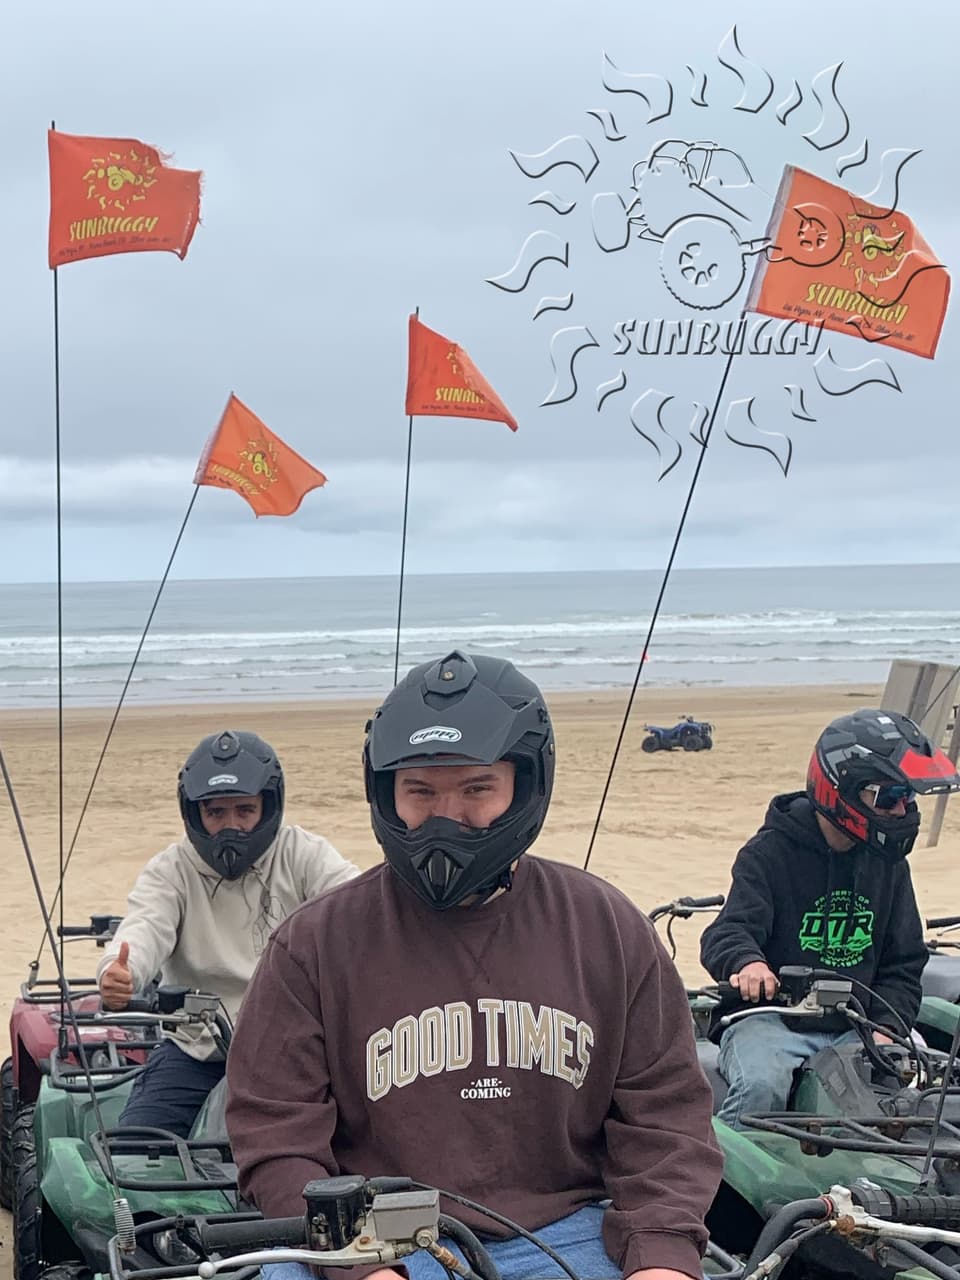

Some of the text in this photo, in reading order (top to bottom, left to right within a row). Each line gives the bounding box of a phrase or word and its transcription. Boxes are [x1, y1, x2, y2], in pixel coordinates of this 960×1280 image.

[70, 216, 159, 241] SUNBUGGY
[805, 282, 909, 324] SUNBUGGY
[435, 387, 484, 404] SUNBU
[801, 915, 872, 938] DTR
[366, 998, 595, 1102] GOOD TIMES
[460, 1087, 511, 1099] COMING
